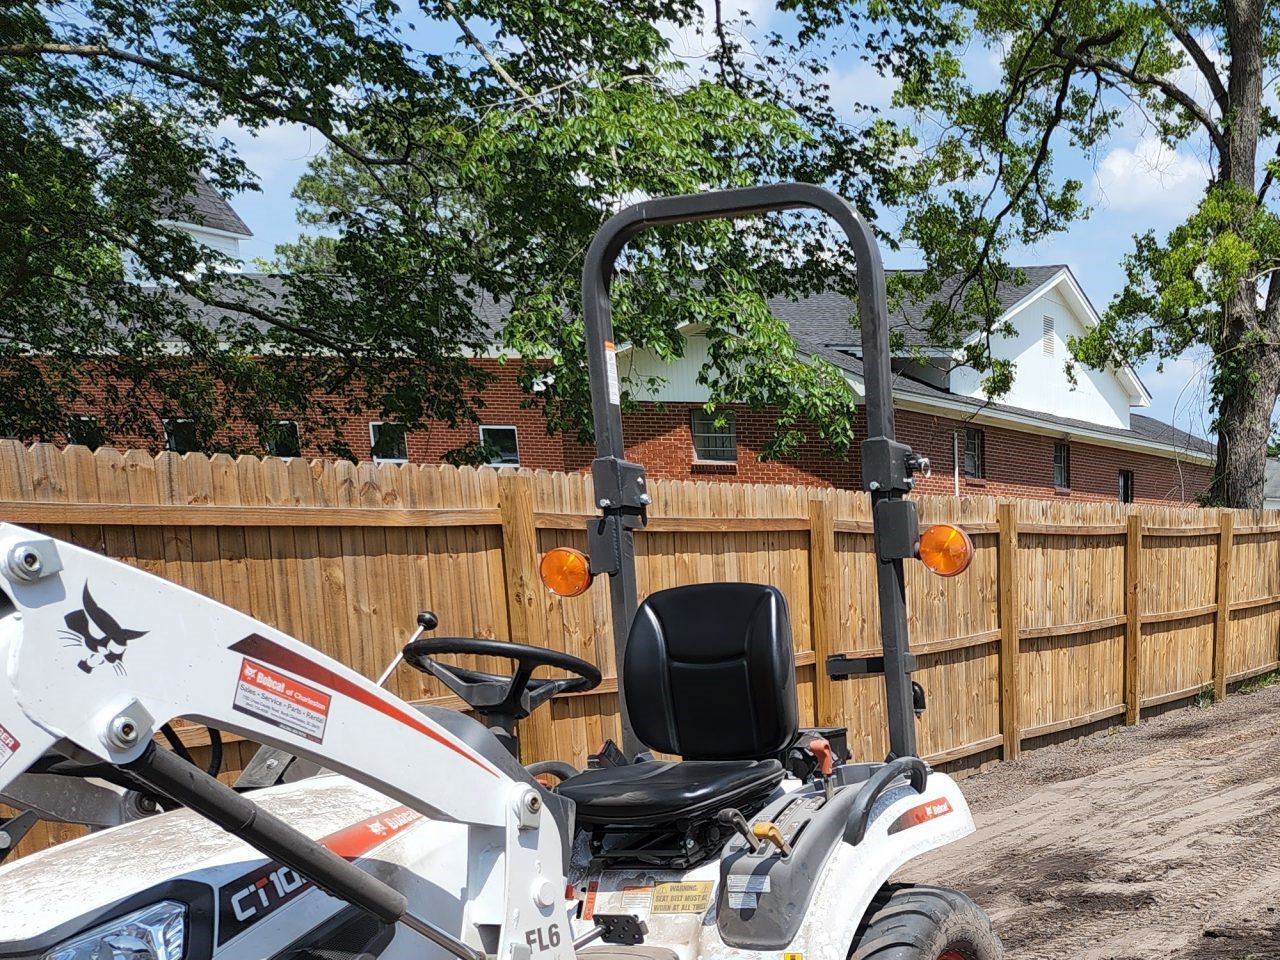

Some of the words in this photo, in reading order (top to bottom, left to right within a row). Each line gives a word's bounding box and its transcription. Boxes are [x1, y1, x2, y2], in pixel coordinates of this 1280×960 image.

[240, 684, 256, 695] Sales
[261, 692, 282, 706] Service
[287, 703, 301, 714] Parts
[257, 671, 285, 692] Bobcat
[294, 691, 326, 710] Charleston
[231, 866, 306, 922] CT10
[685, 894, 700, 902] MUST
[525, 923, 561, 955] FL6
